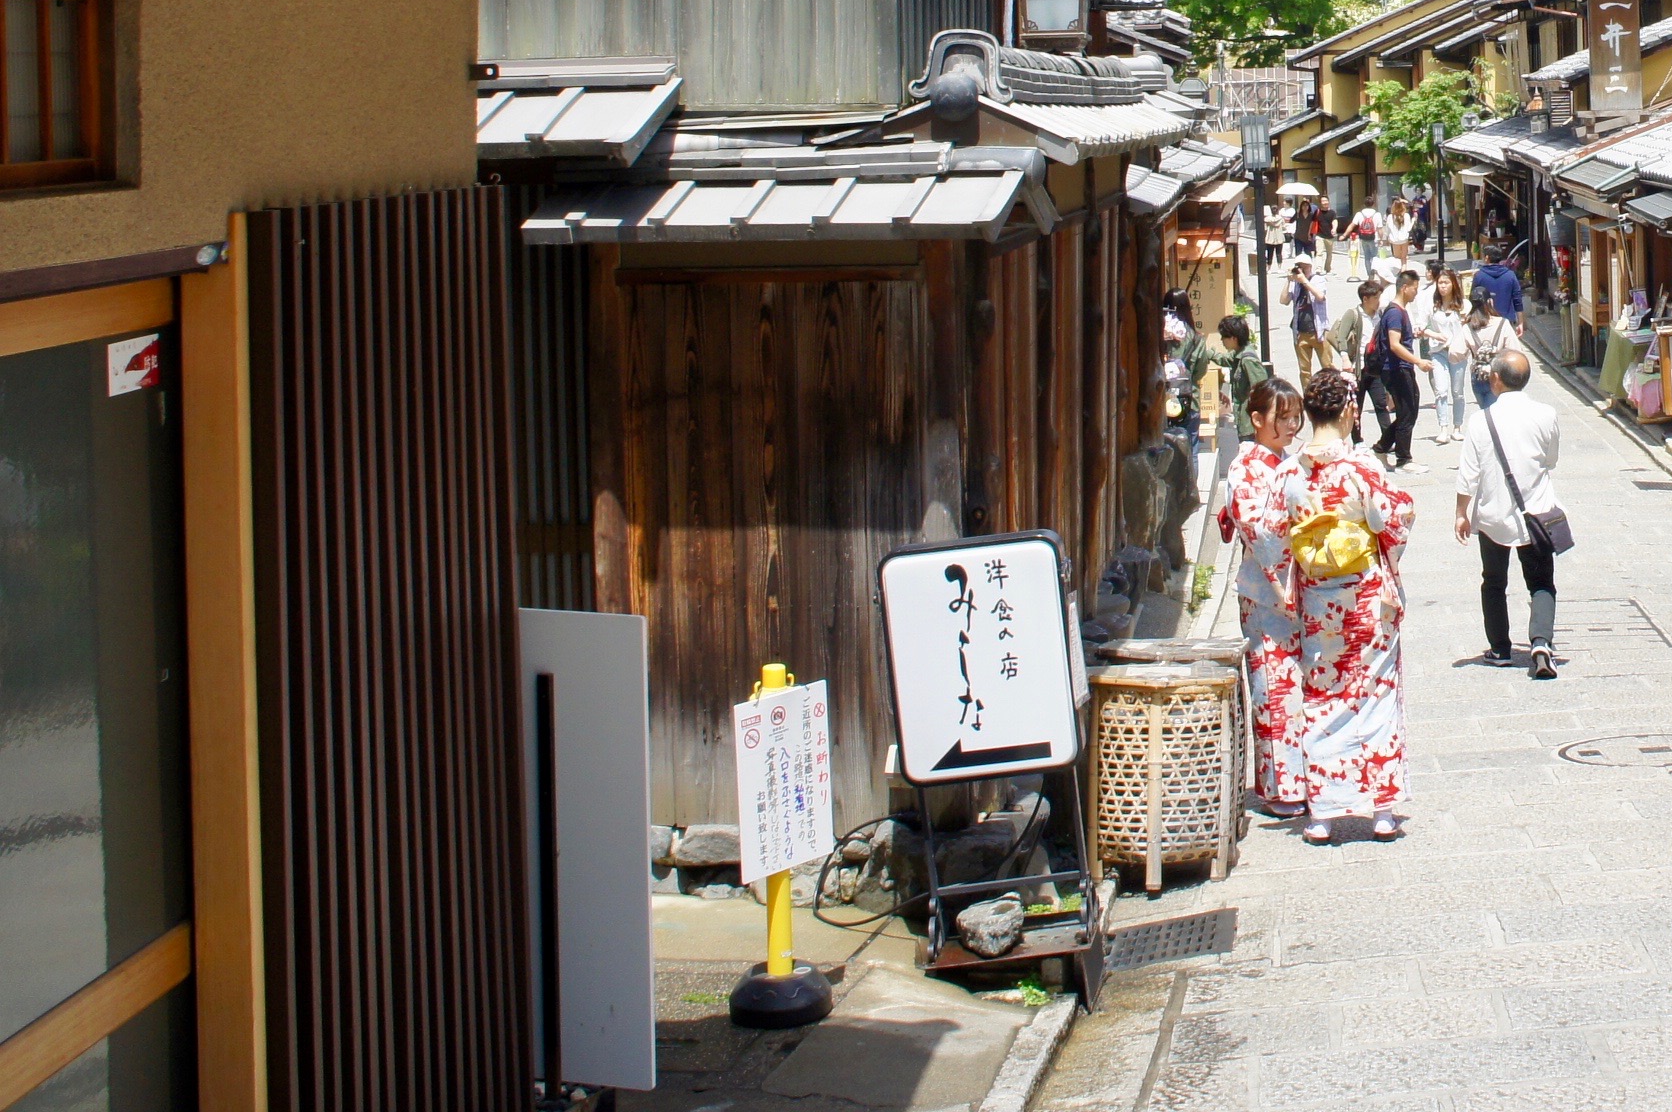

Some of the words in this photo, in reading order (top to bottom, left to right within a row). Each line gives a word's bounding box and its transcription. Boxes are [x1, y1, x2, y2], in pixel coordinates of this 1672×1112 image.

[945, 564, 984, 731] みしな
[985, 559, 1018, 680] 洋食の店
[779, 746, 793, 860] 入口をふさぐような
[815, 731, 829, 806] お断わり
